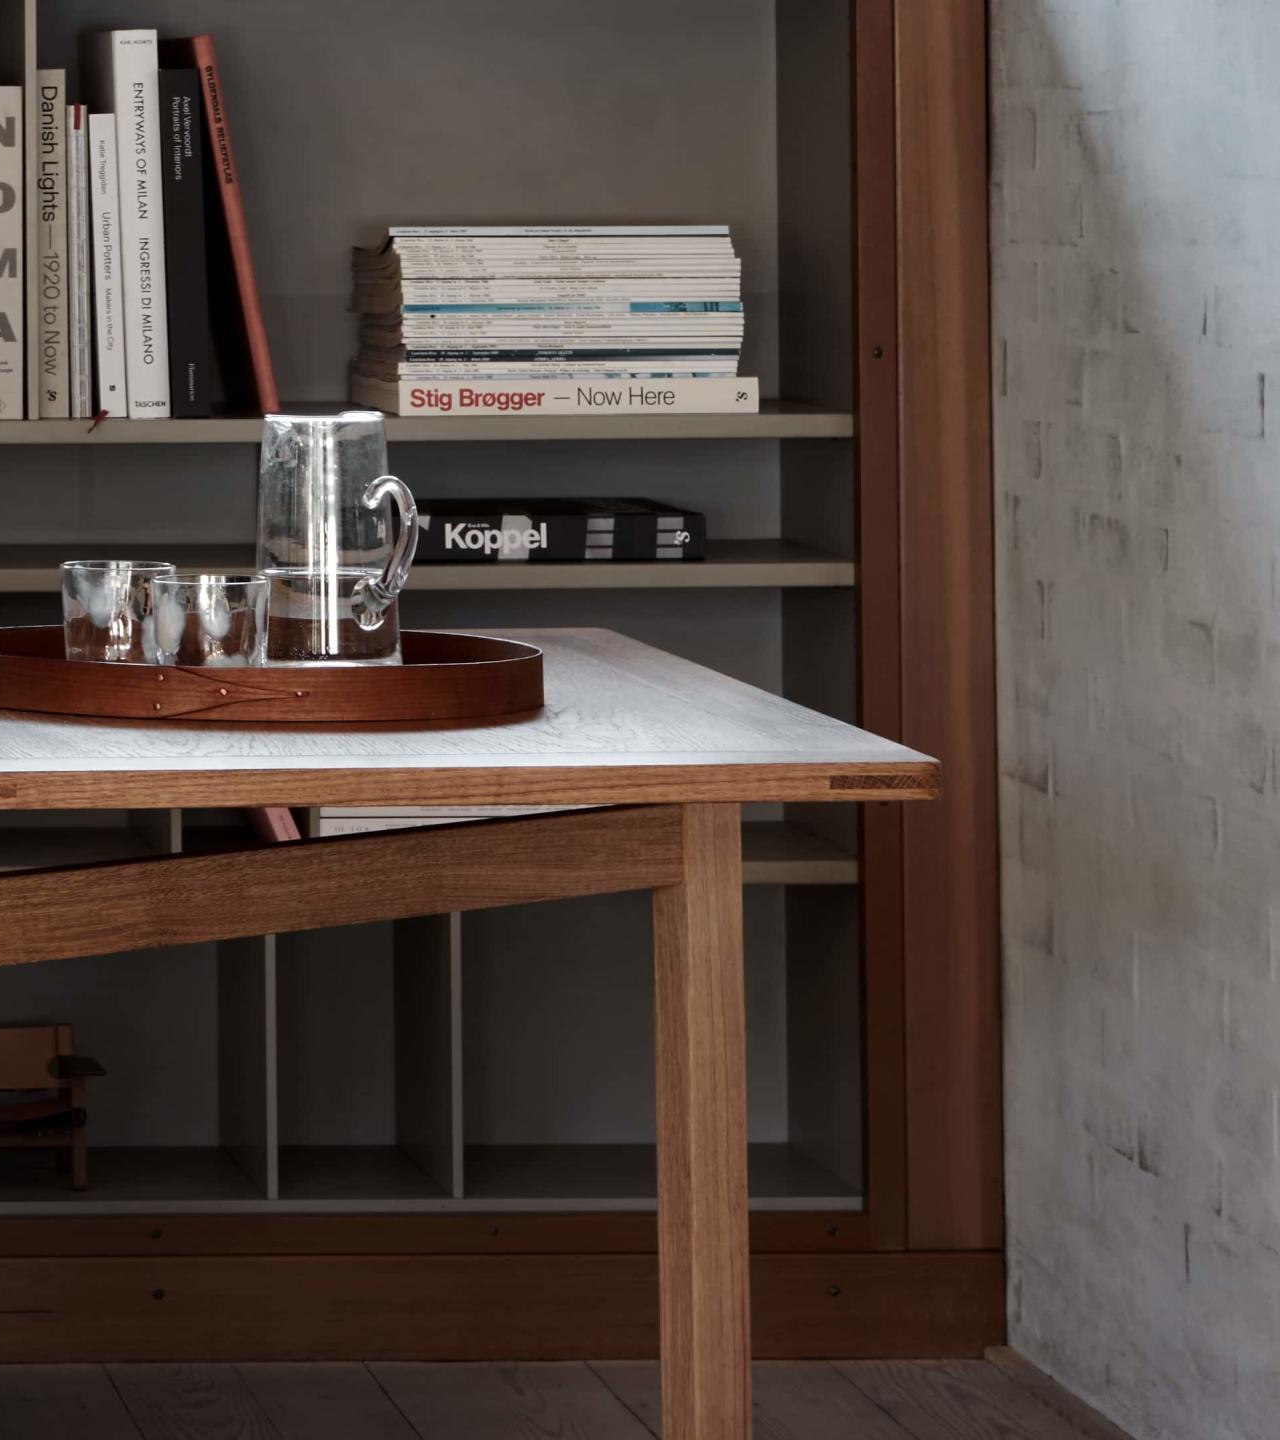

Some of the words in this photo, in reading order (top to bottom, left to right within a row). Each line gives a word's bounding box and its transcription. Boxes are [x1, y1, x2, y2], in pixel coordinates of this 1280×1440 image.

[40, 86, 59, 154] Danish
[133, 82, 146, 155] ENTRYWAYS
[172, 96, 180, 132] Portraits
[183, 96, 191, 115] Axel
[184, 116, 192, 158] Vervoordt
[205, 65, 223, 124] GYLDENDALS
[214, 126, 233, 185] RELIEFATLAS
[99, 139, 107, 158] Katie
[135, 157, 147, 176] OF
[136, 179, 148, 220] MILAN
[102, 211, 111, 242] Urban
[103, 243, 113, 281] Potters
[139, 237, 151, 294] INGRESSI
[43, 304, 59, 326] to
[141, 297, 152, 309] DI
[43, 330, 60, 376] Now
[106, 334, 114, 351] City
[141, 313, 154, 365] MILANO
[409, 388, 452, 411] Stig
[458, 388, 545, 410] Brøgger
[577, 386, 623, 406] Now
[628, 386, 676, 406] Here
[444, 522, 547, 555] Koppel
